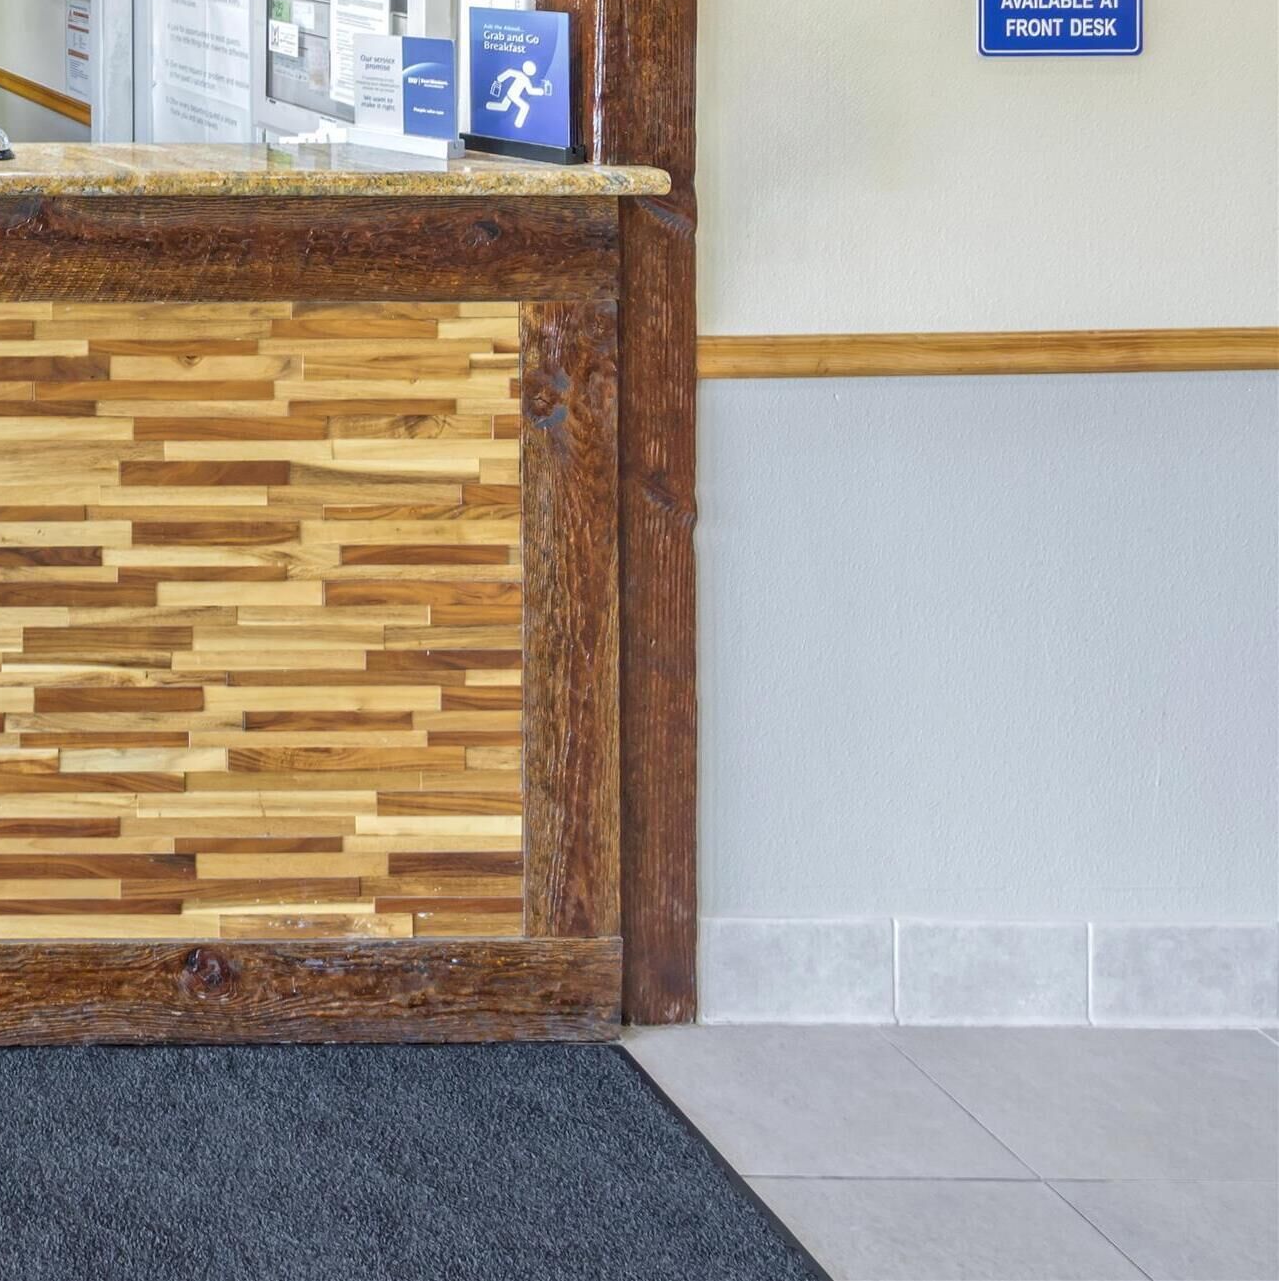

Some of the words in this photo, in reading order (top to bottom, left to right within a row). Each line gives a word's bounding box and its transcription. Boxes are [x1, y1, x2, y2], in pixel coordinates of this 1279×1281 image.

[1006, 18, 1064, 36] FRONT
[1070, 18, 1117, 36] DESK
[484, 30, 504, 40] Grab
[506, 34, 524, 42] and
[526, 34, 540, 44] Go
[484, 40, 526, 54] Breakfast
[365, 63, 390, 72] promise
